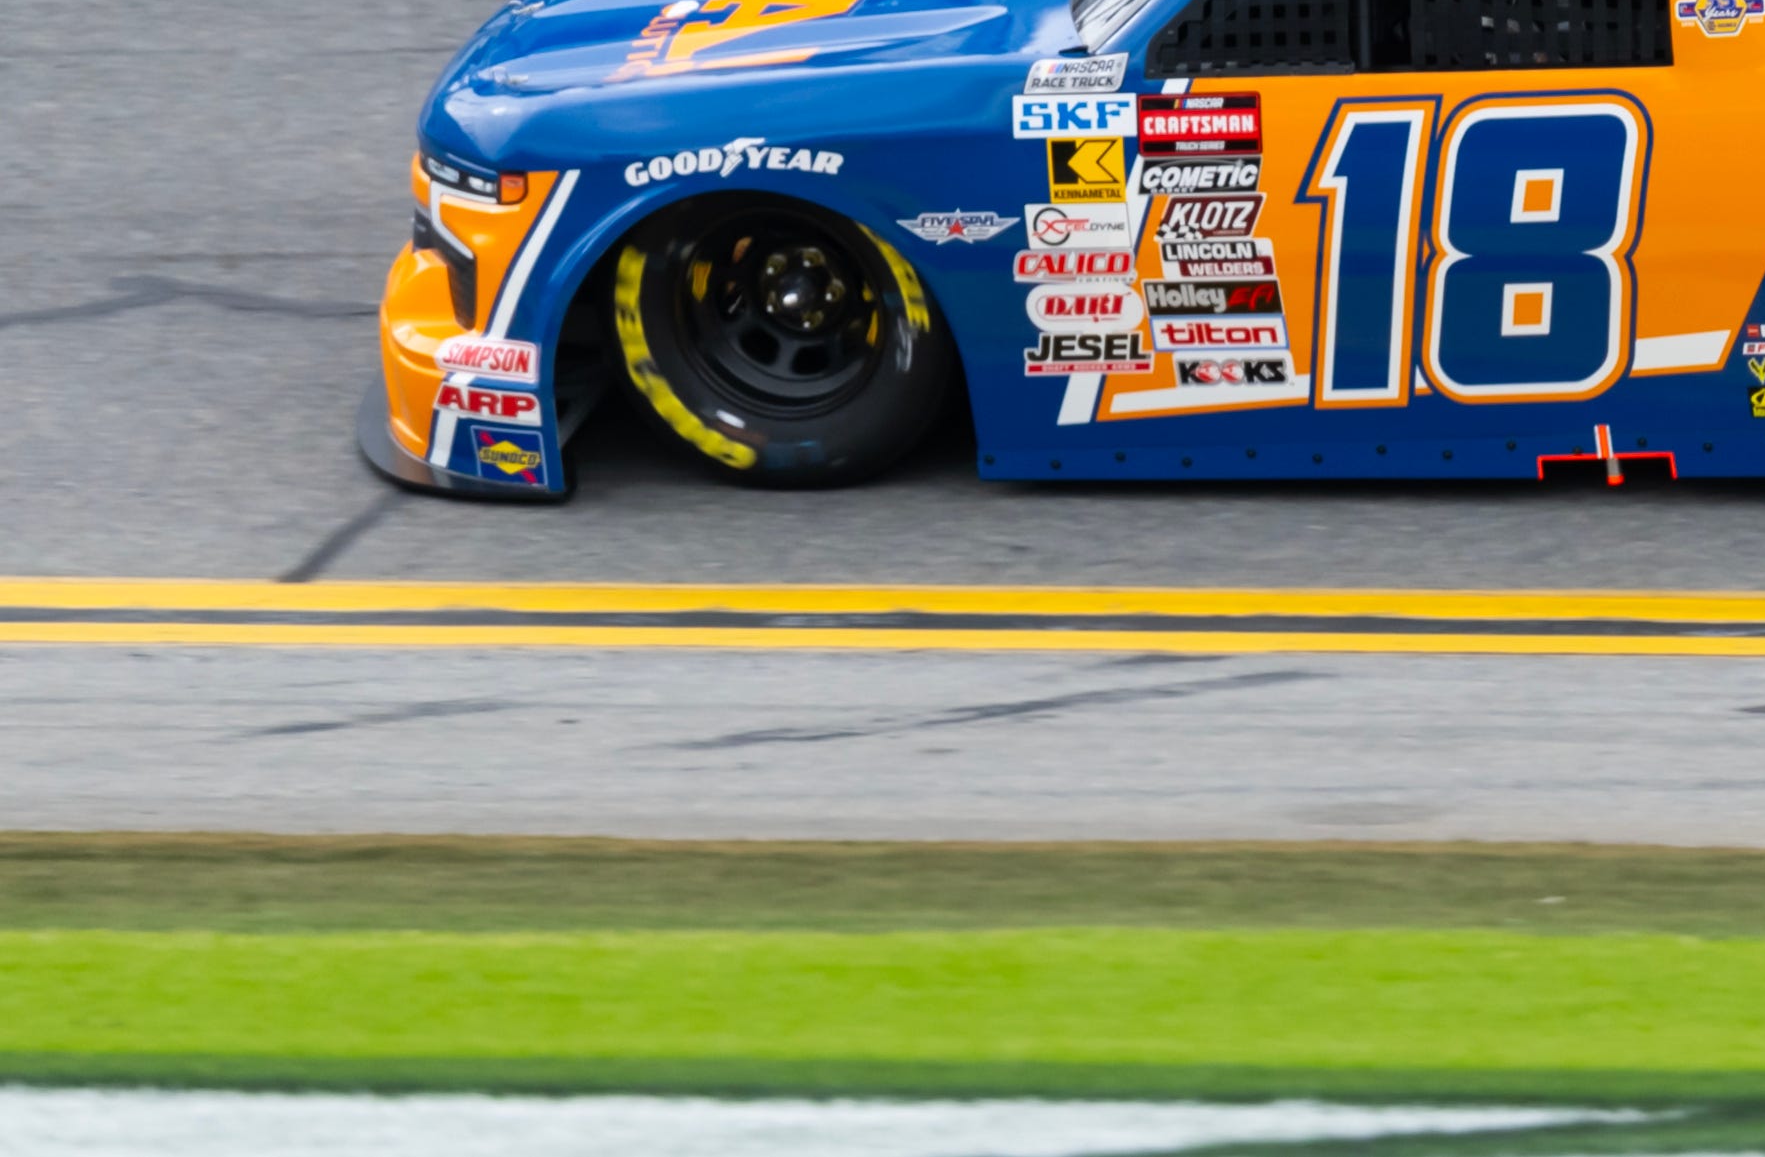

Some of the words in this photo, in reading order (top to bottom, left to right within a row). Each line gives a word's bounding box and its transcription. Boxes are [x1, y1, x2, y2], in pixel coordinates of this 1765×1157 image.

[1059, 59, 1115, 74] NASCAR
[1031, 77, 1067, 88] RACE
[1071, 75, 1115, 88] TRUCK
[1020, 101, 1130, 131] SKF
[1185, 97, 1224, 109] NASCAR
[1143, 114, 1255, 135] CRAFTSMAN
[623, 138, 845, 188] GOODYEAR
[1142, 163, 1259, 190] COMETIC
[1053, 188, 1122, 199] KENNAMETAL
[920, 216, 952, 228] FIVE
[1167, 200, 1256, 231] KLOTZ
[1165, 242, 1253, 261] LINCOLN
[1292, 88, 1654, 410] 18
[1017, 252, 1131, 277] CALICO
[1187, 261, 1265, 277] WELDERS
[1044, 294, 1124, 323] DART
[1146, 283, 1228, 314] Holley
[1160, 322, 1278, 345] tilton
[442, 343, 531, 374] SIMPSON
[1026, 333, 1148, 362] JESEL
[1177, 358, 1287, 385] KOOKS
[437, 384, 537, 418] ARP
[481, 447, 541, 467] SUNOCO
